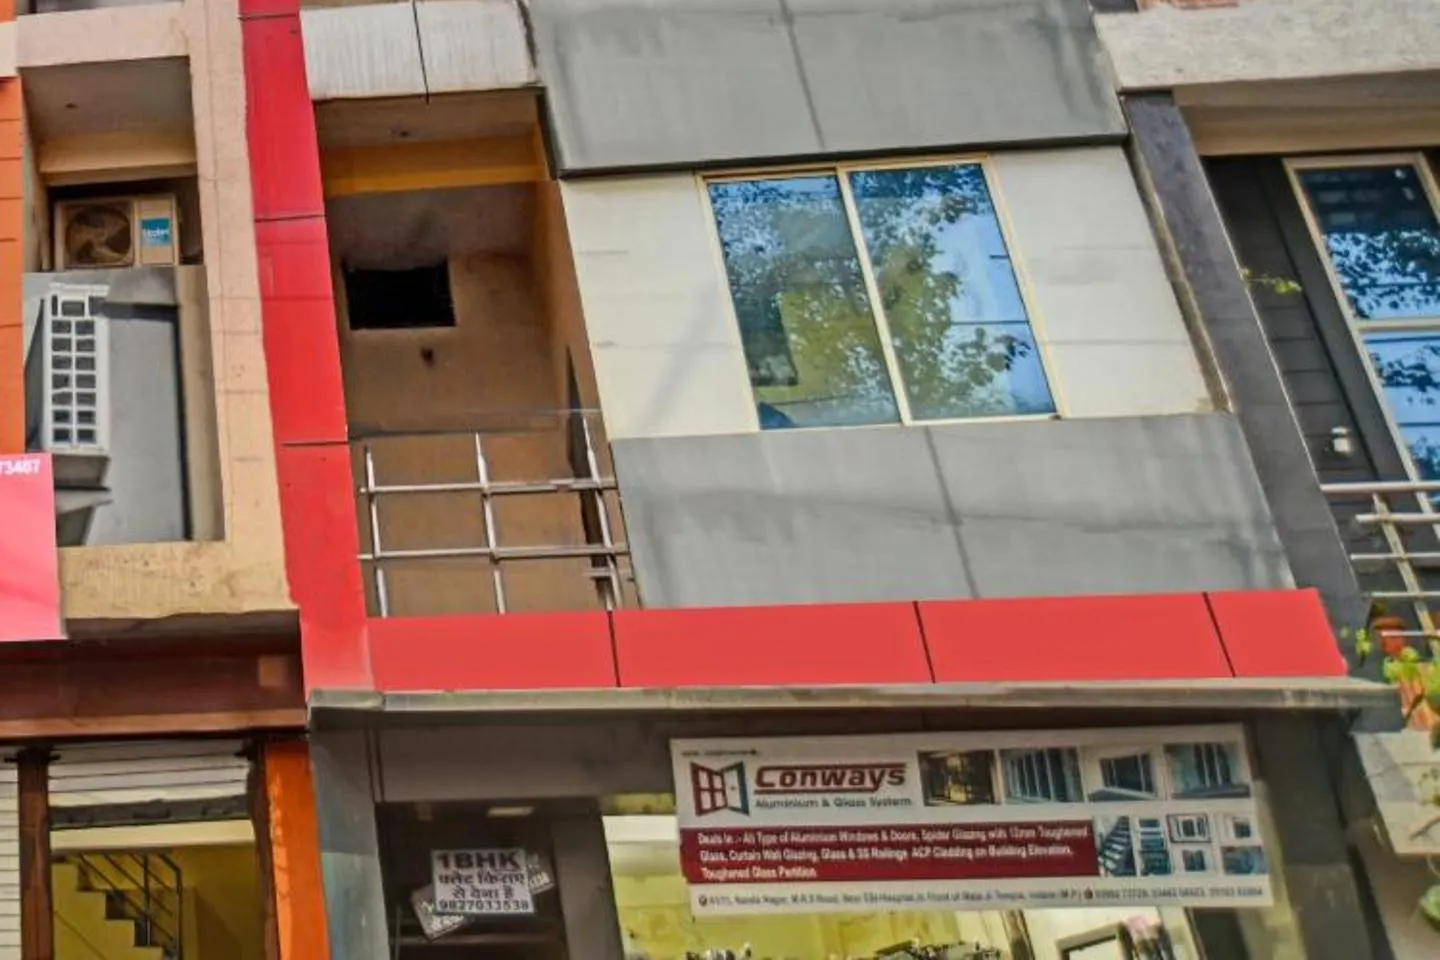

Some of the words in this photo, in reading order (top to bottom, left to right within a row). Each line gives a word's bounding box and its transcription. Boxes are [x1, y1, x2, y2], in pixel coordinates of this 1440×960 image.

[755, 762, 907, 794] Conways
[755, 797, 818, 809] Aluminium
[834, 797, 866, 808] Glass
[437, 851, 520, 869] 1BHK
